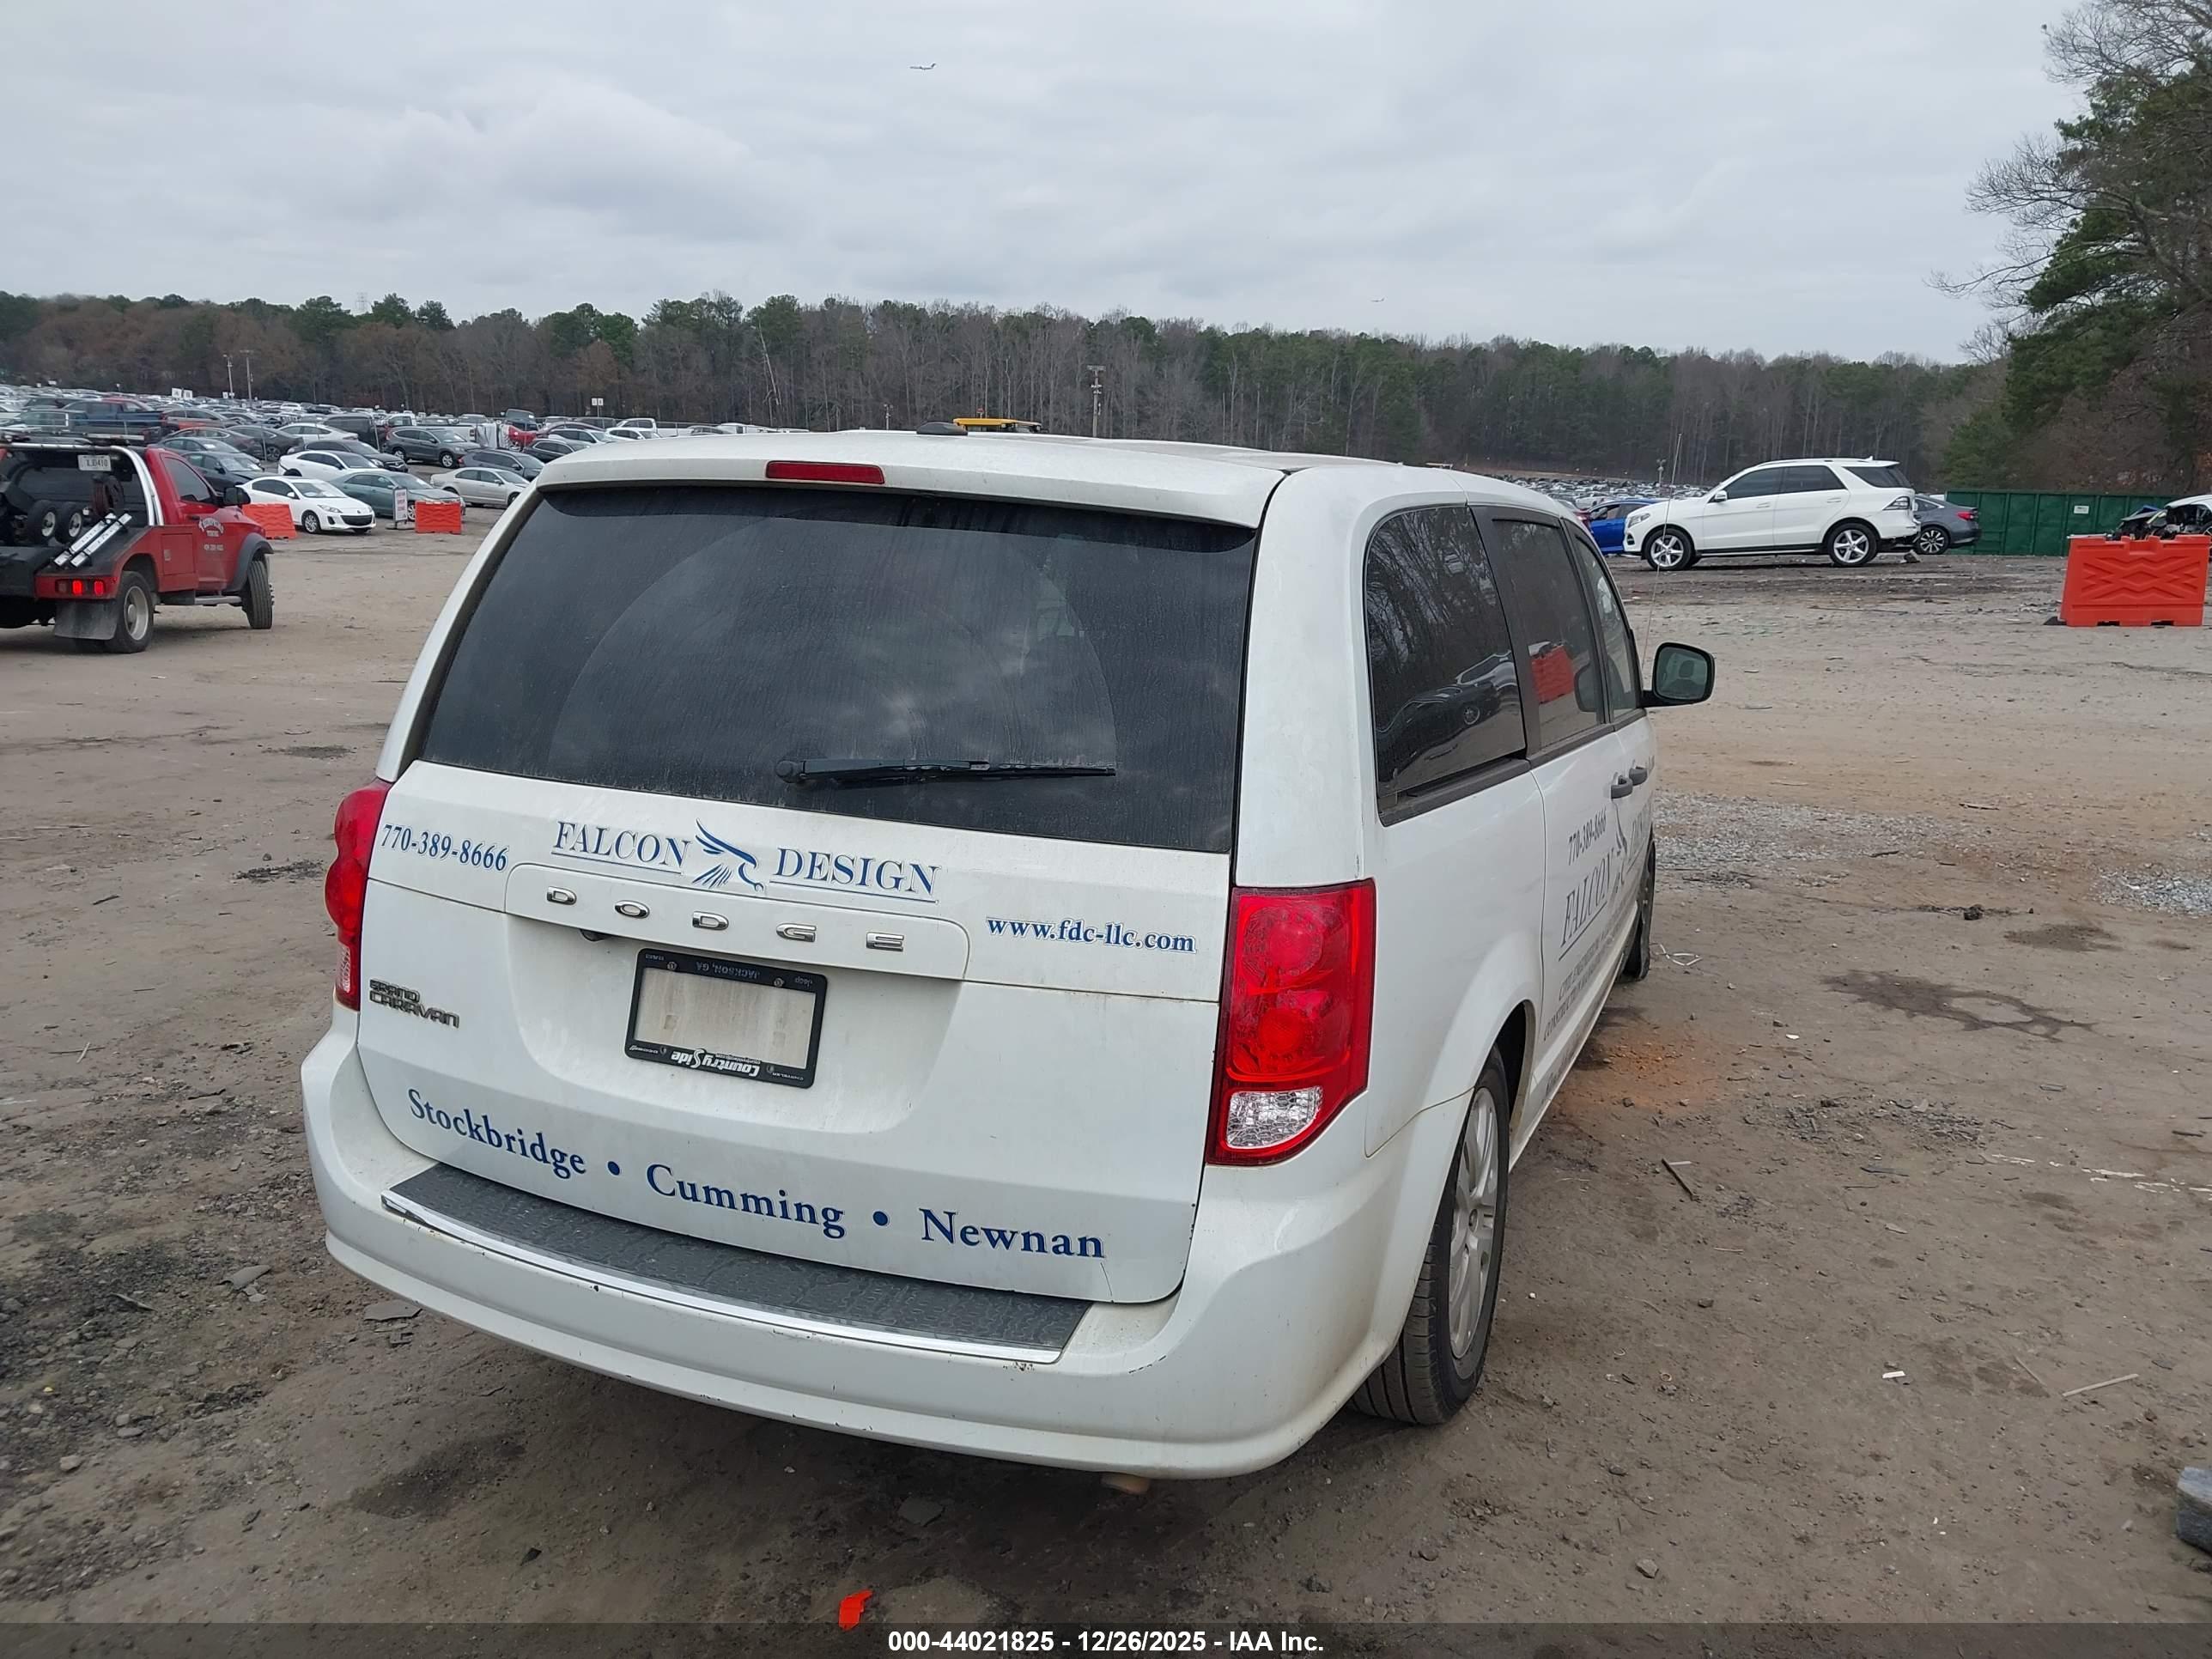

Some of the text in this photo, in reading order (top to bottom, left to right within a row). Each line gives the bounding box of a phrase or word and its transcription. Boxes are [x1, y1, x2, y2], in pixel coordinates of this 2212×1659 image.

[381, 823, 508, 871] 770-389-8666
[553, 821, 942, 895] FALCON DESIGN
[1568, 805, 1607, 867] 770-389-8666
[546, 885, 905, 952] DODGE
[1560, 847, 1615, 948] FALCON
[987, 918, 1195, 952] www.fdc-llc.com
[369, 979, 420, 1003] GRAND
[369, 990, 460, 1029] CARAVAN
[407, 1088, 1105, 1259] Stockbridge Cumming Newnan
